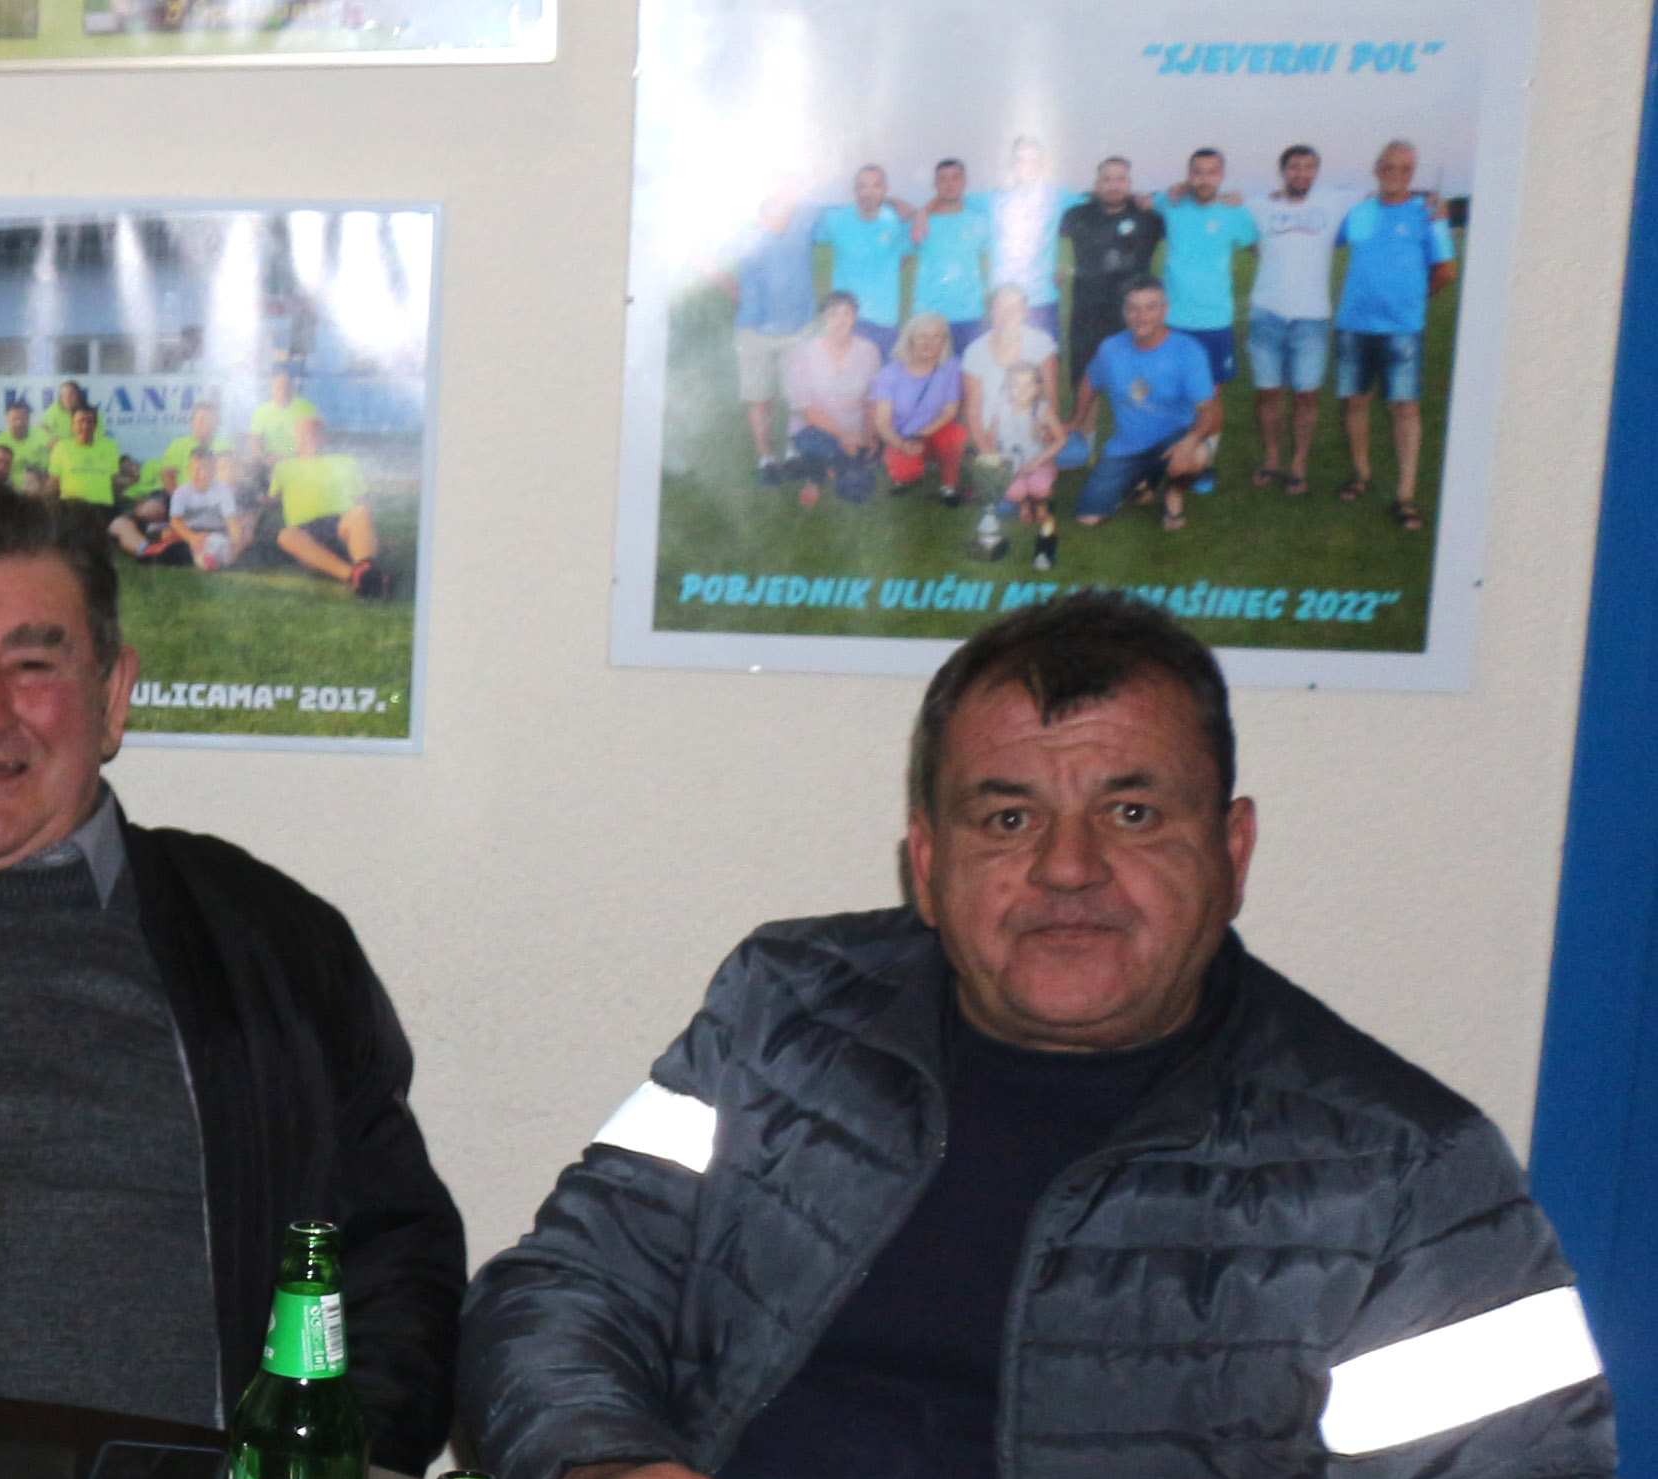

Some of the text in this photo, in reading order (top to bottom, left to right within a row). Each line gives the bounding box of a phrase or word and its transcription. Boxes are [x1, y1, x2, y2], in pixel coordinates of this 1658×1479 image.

[679, 572, 873, 610] POBJEDNIK
[879, 571, 995, 612] ULIČNI
[297, 685, 388, 714] 2017.
